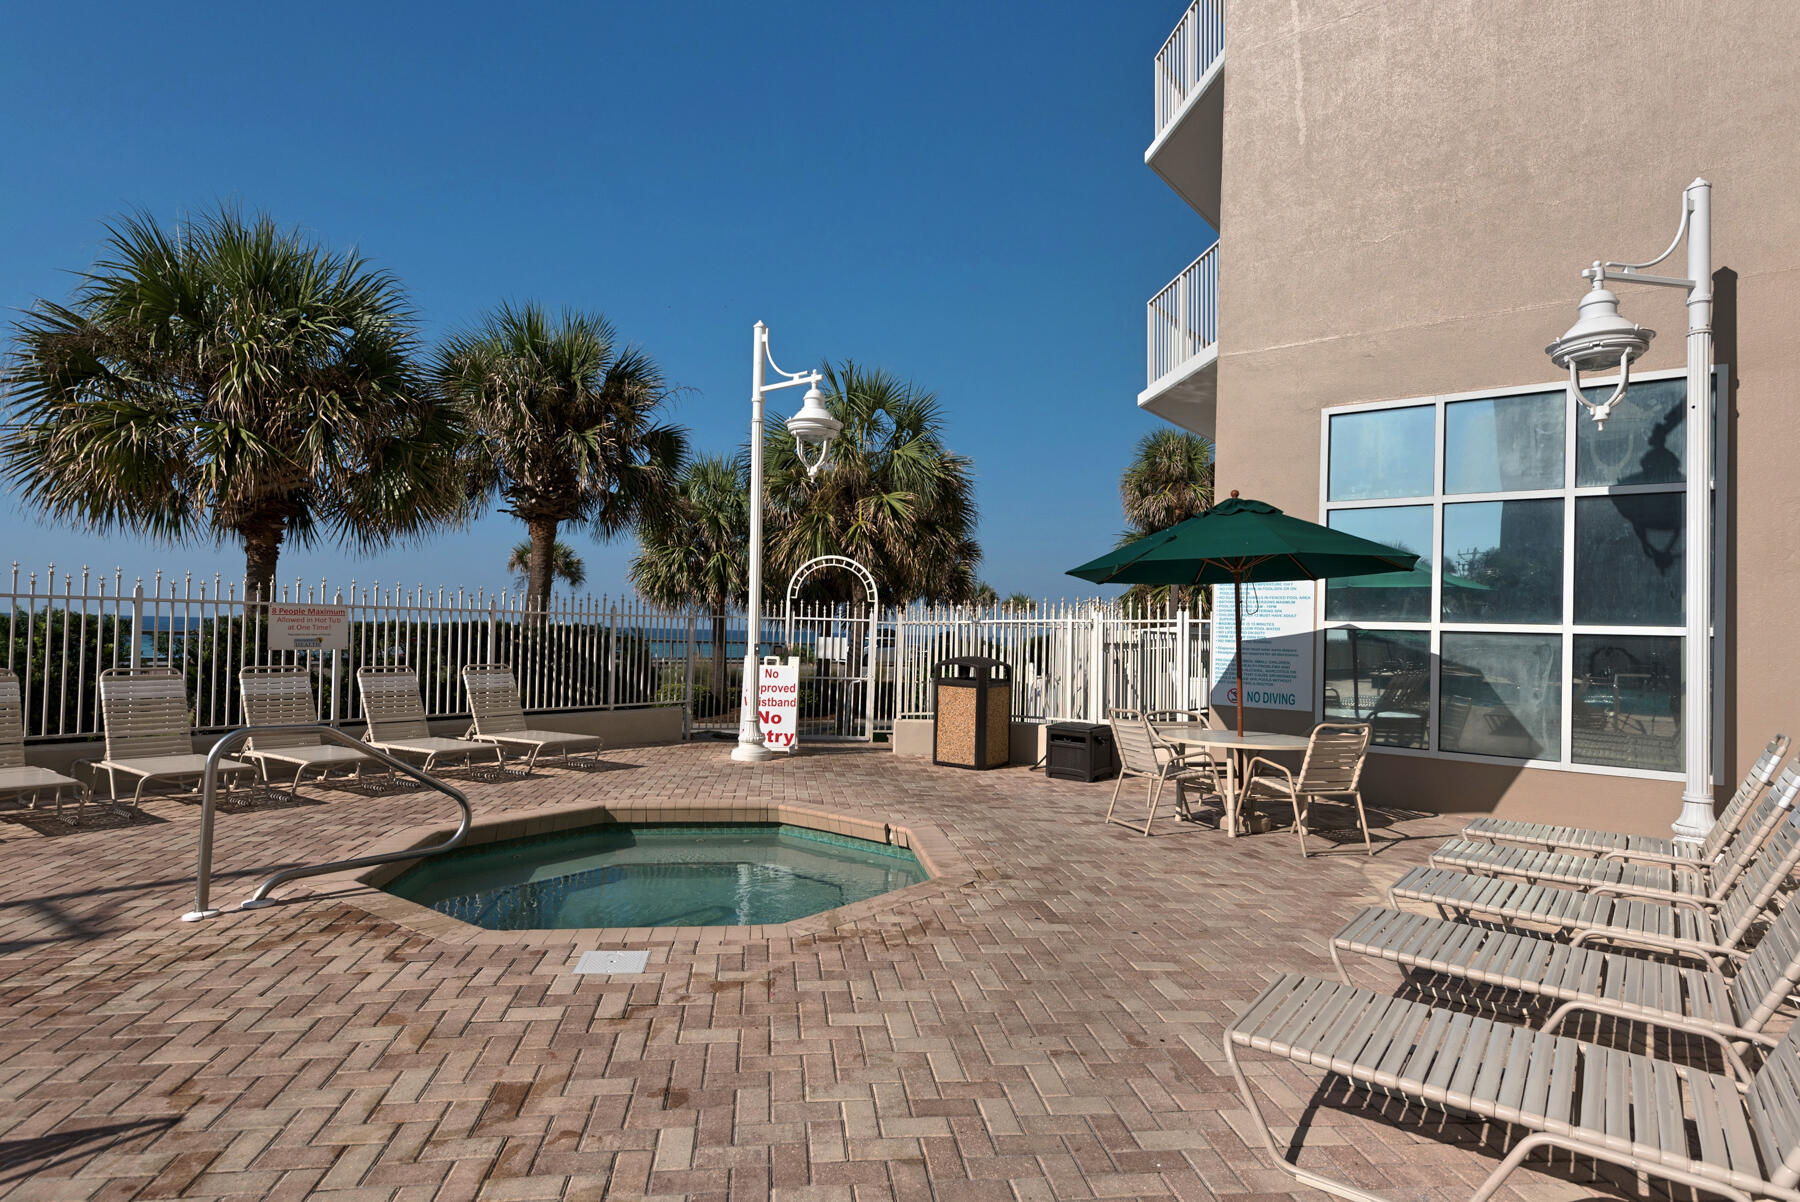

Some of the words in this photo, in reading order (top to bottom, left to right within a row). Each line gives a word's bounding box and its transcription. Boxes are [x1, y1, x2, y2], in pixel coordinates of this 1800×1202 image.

[279, 607, 306, 615] People
[764, 668, 779, 679] No
[758, 683, 796, 694] proved
[758, 697, 797, 708] istband
[1247, 690, 1261, 704] NO
[1262, 691, 1296, 706] DIVING
[758, 710, 783, 725] No
[762, 729, 795, 747] try
